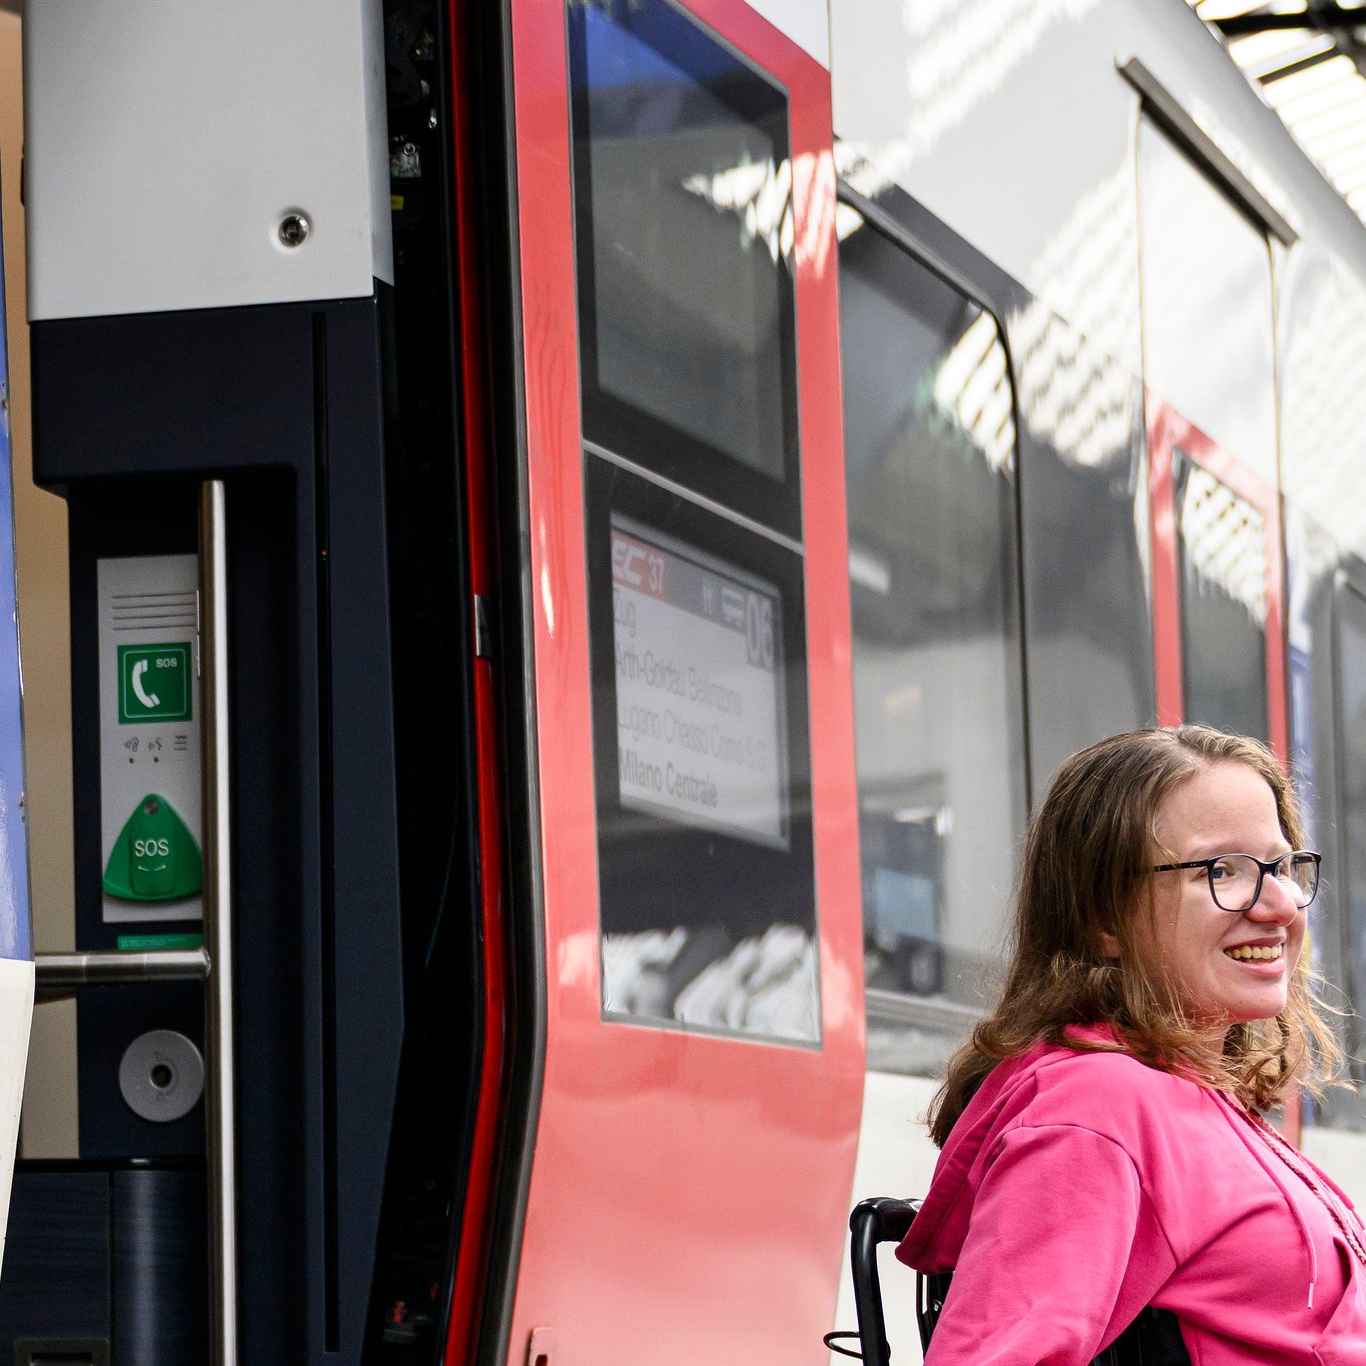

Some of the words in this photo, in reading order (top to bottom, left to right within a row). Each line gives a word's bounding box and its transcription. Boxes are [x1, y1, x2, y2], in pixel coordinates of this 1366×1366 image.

[611, 538, 647, 586] EC
[613, 588, 635, 639] Zug
[156, 658, 177, 668] SOS
[618, 700, 661, 741] Lugano
[620, 746, 662, 792] Milano
[666, 761, 717, 809] Centrale
[135, 839, 169, 857] SOS
